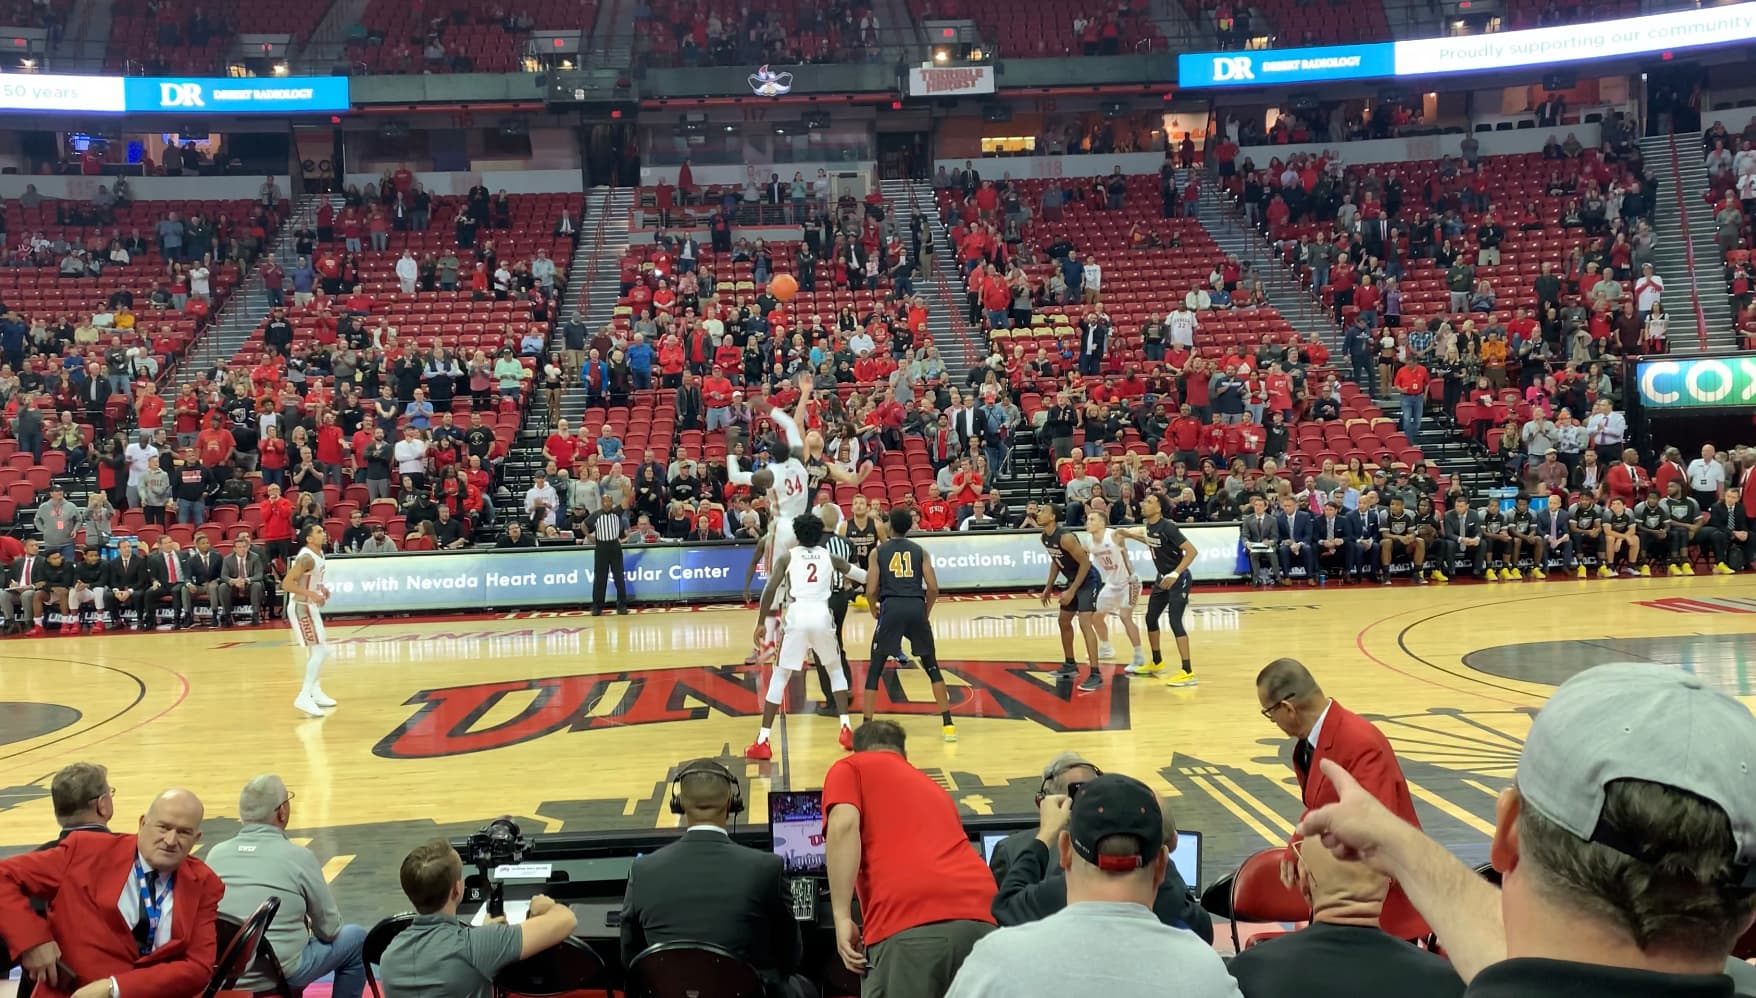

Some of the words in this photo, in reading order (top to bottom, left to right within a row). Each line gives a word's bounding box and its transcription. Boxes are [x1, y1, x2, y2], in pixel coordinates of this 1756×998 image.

[1439, 45, 1503, 61] Proudly
[1509, 34, 1606, 57] supporting
[1611, 31, 1640, 44] our
[1648, 15, 1753, 39] community
[1213, 57, 1254, 81] DR
[3, 84, 29, 98] 50
[32, 85, 79, 102] years
[160, 82, 205, 106] DR
[785, 474, 803, 497] 34
[806, 562, 818, 583] 2
[888, 551, 914, 578] 41
[361, 576, 399, 591] with
[407, 574, 479, 590] Nevada
[486, 572, 537, 588] Heart
[543, 569, 578, 585] and
[669, 565, 730, 580] Center
[371, 660, 1131, 759] UNLV
